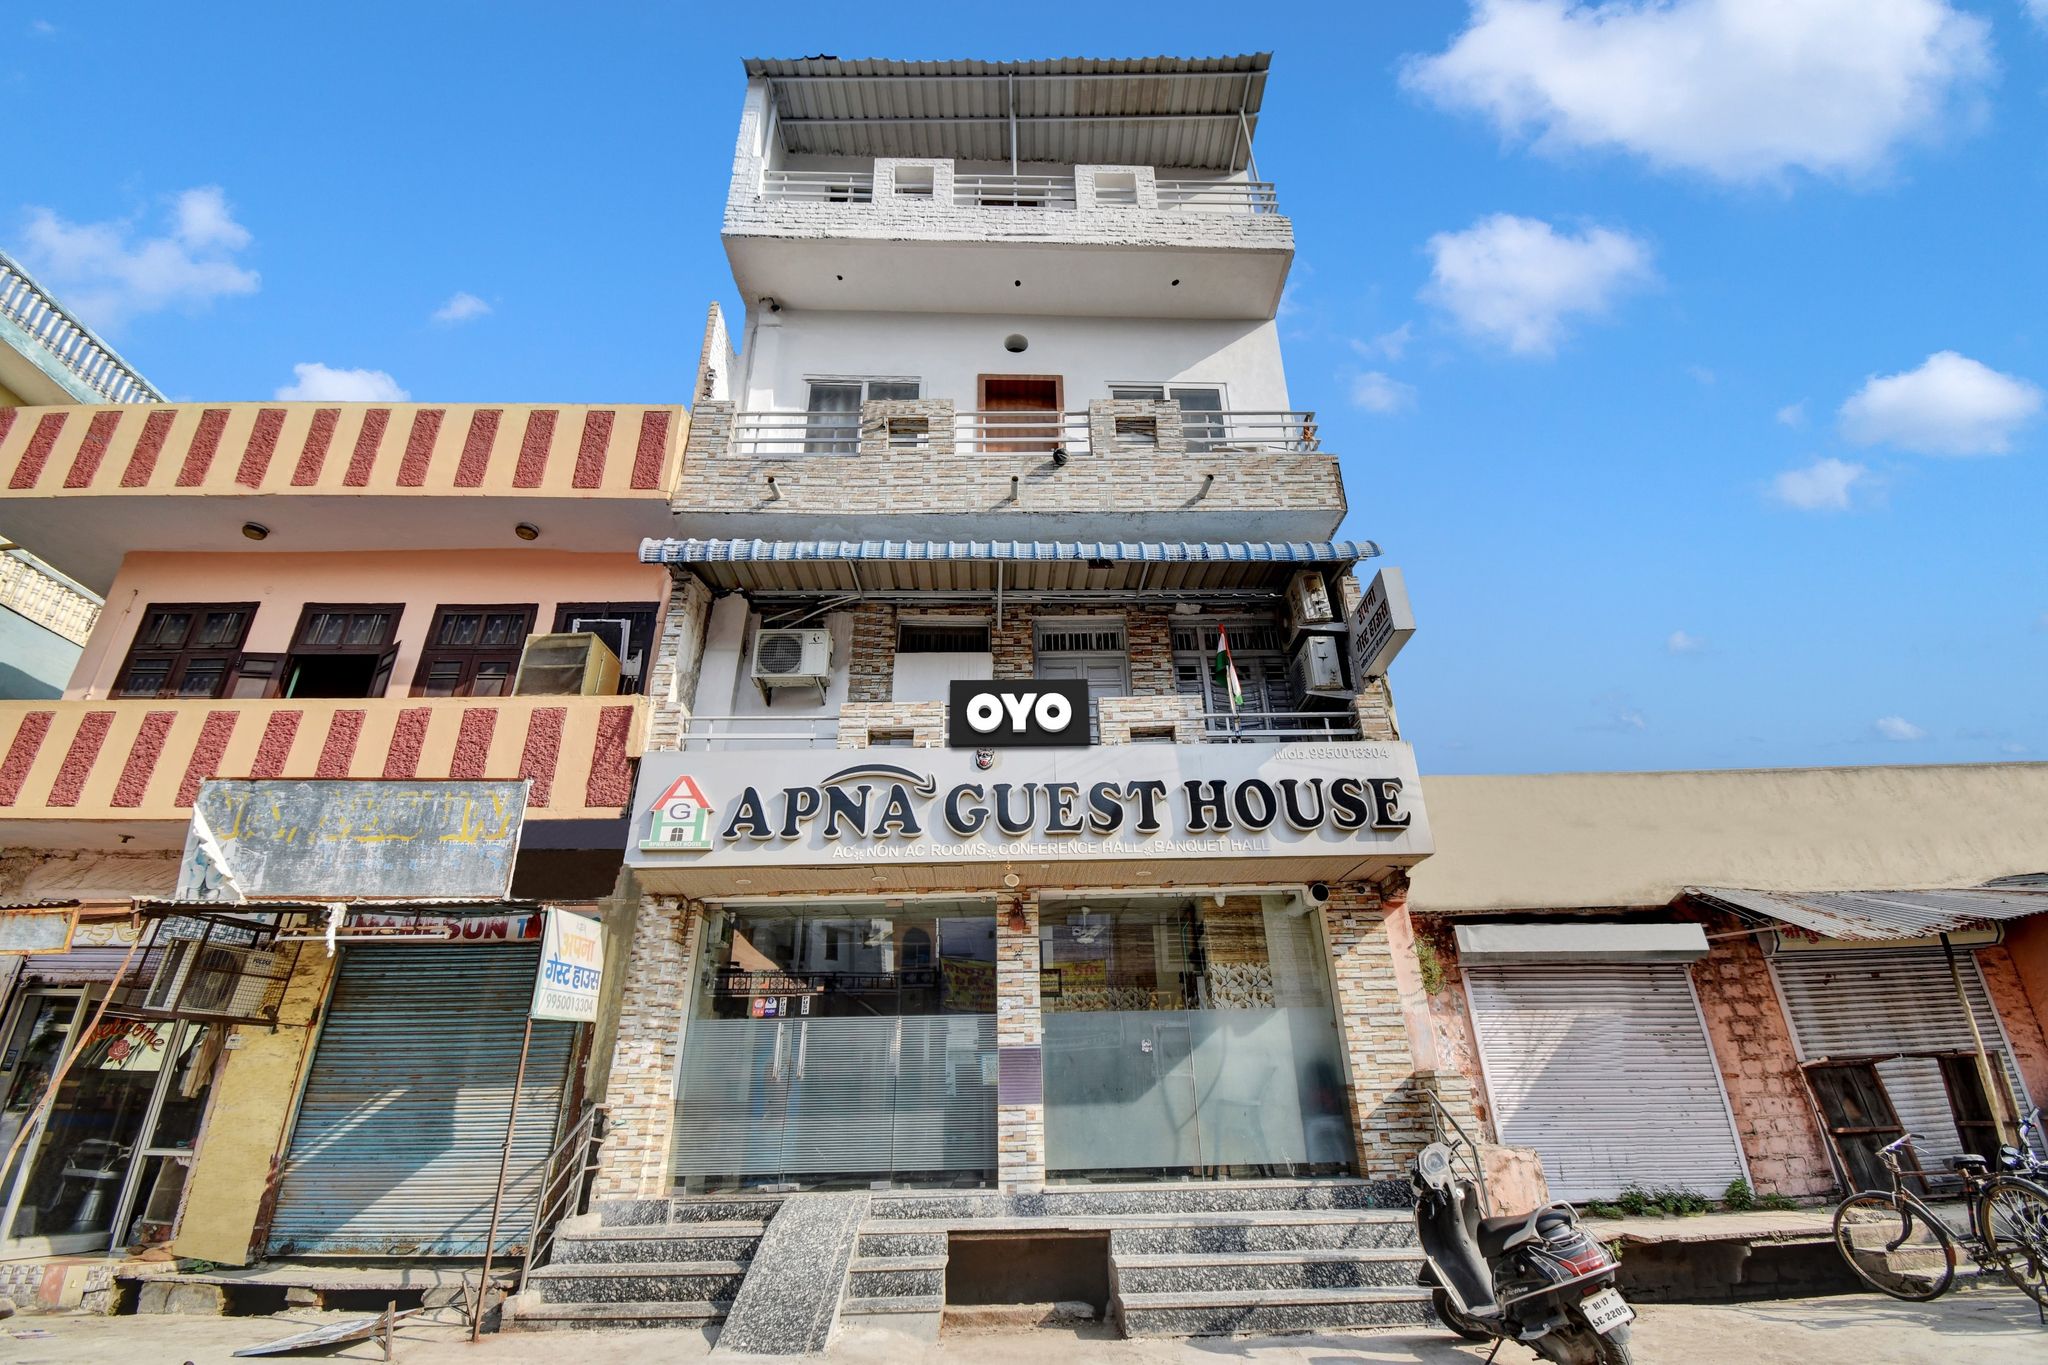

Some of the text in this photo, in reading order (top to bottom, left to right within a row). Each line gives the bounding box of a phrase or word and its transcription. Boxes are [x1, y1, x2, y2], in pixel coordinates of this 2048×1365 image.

[966, 692, 1073, 735] OYO
[721, 775, 1412, 840] APNA GUEST HOUSE
[832, 838, 1271, 858] AC NON AC ROOMS CONFERENCE HALL BANQUET HALL
[560, 932, 596, 962] अपना
[545, 952, 601, 990] गेस्ट हाउस
[546, 993, 593, 1013] 9950013304
